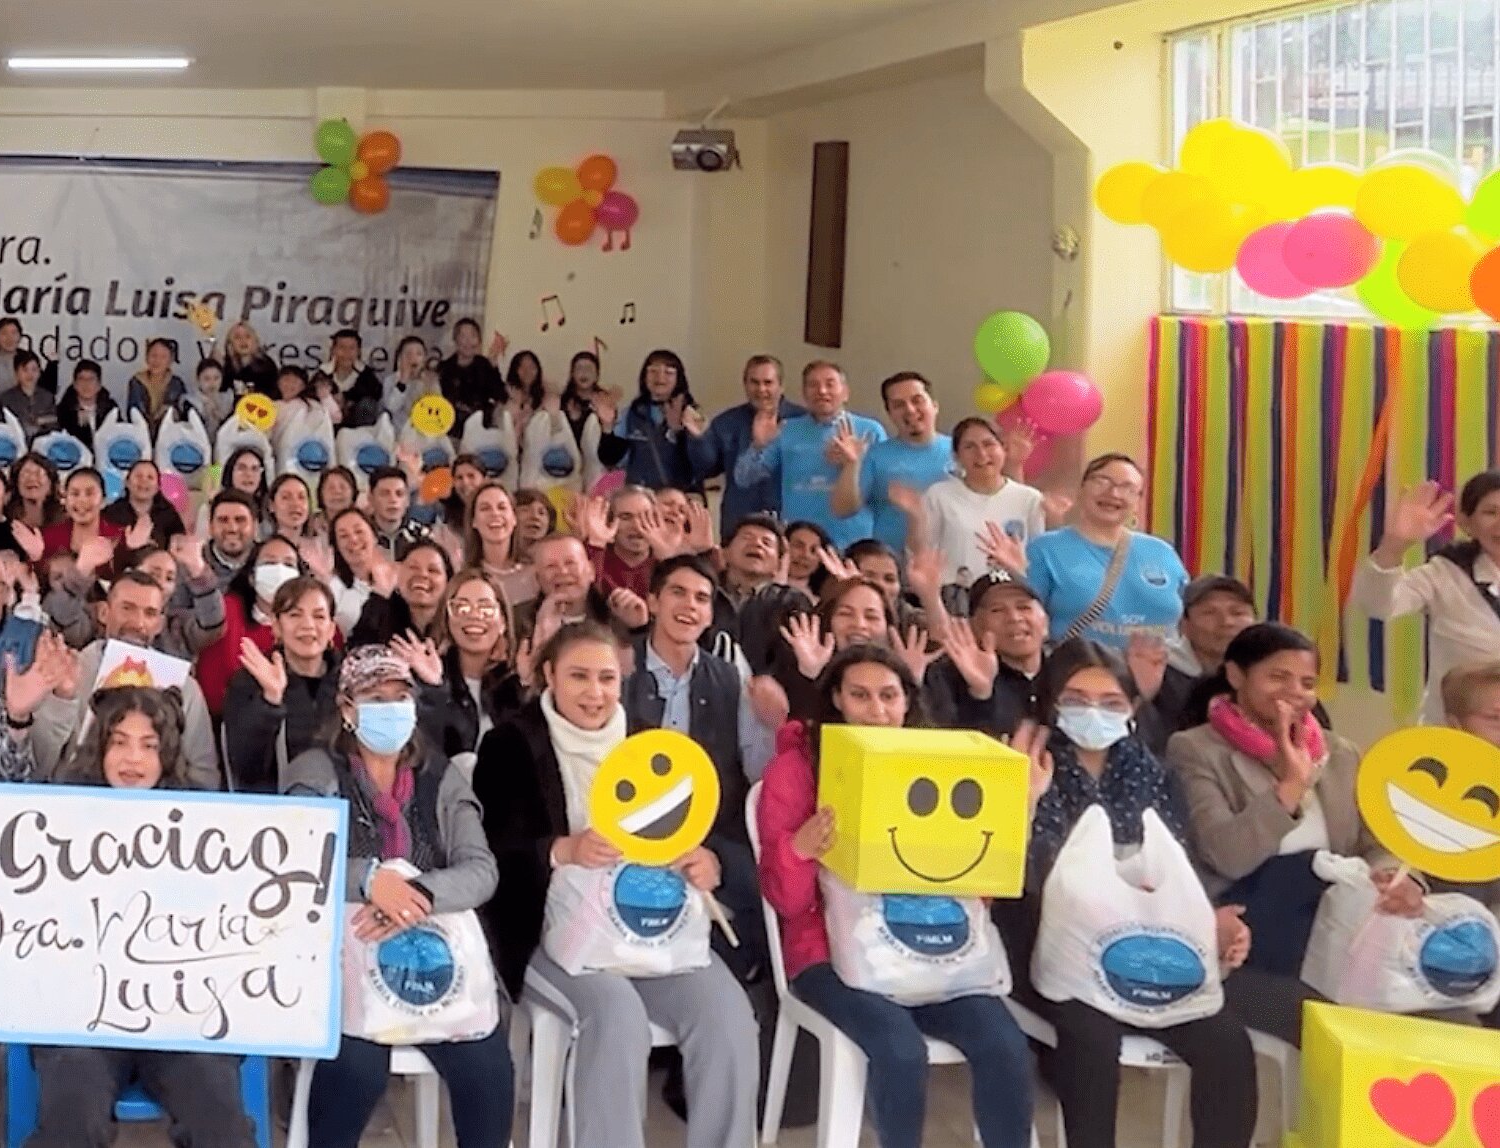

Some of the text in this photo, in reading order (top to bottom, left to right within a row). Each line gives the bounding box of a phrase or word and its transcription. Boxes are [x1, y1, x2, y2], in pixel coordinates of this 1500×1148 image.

[104, 276, 224, 320] Luisa
[240, 281, 450, 330] Piraquive
[87, 963, 302, 1041] Luisa
